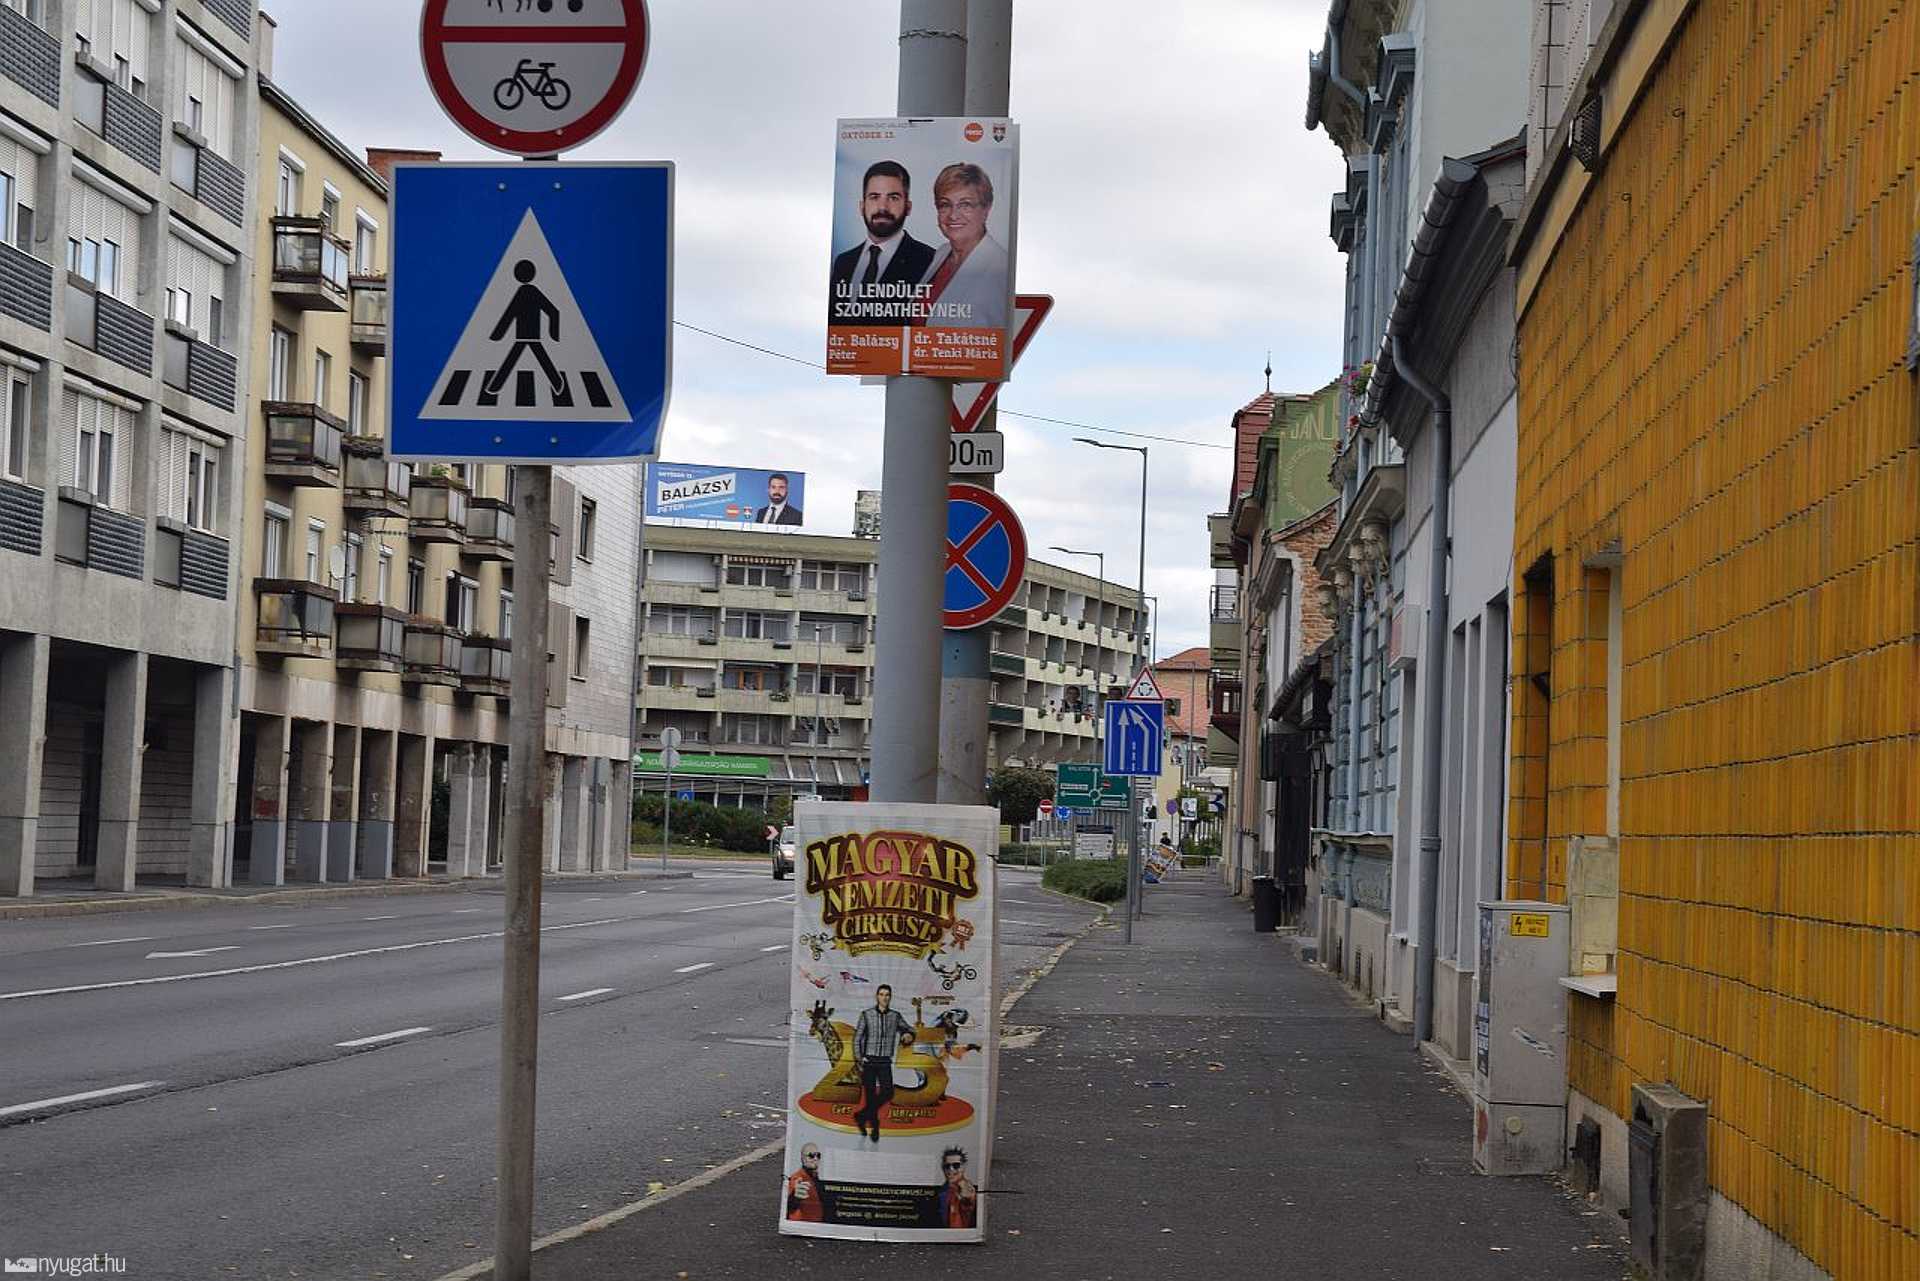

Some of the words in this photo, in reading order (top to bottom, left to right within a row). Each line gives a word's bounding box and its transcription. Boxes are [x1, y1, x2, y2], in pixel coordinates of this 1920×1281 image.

[836, 279, 853, 299] ÚJ
[858, 279, 934, 299] LENDÜLET
[834, 302, 972, 319] SZOMBATHELYNEK!
[829, 334, 847, 347] dr.
[850, 333, 900, 351] Balázsy
[914, 331, 932, 345] dr.
[935, 331, 998, 346] Takátsné
[828, 347, 858, 360] Péter
[913, 345, 929, 358] dr.
[662, 479, 732, 501] BALÁZSY
[809, 838, 973, 890] MAGYAR
[825, 880, 951, 920] NEMZETI
[840, 913, 937, 938] CIRKUSZ
